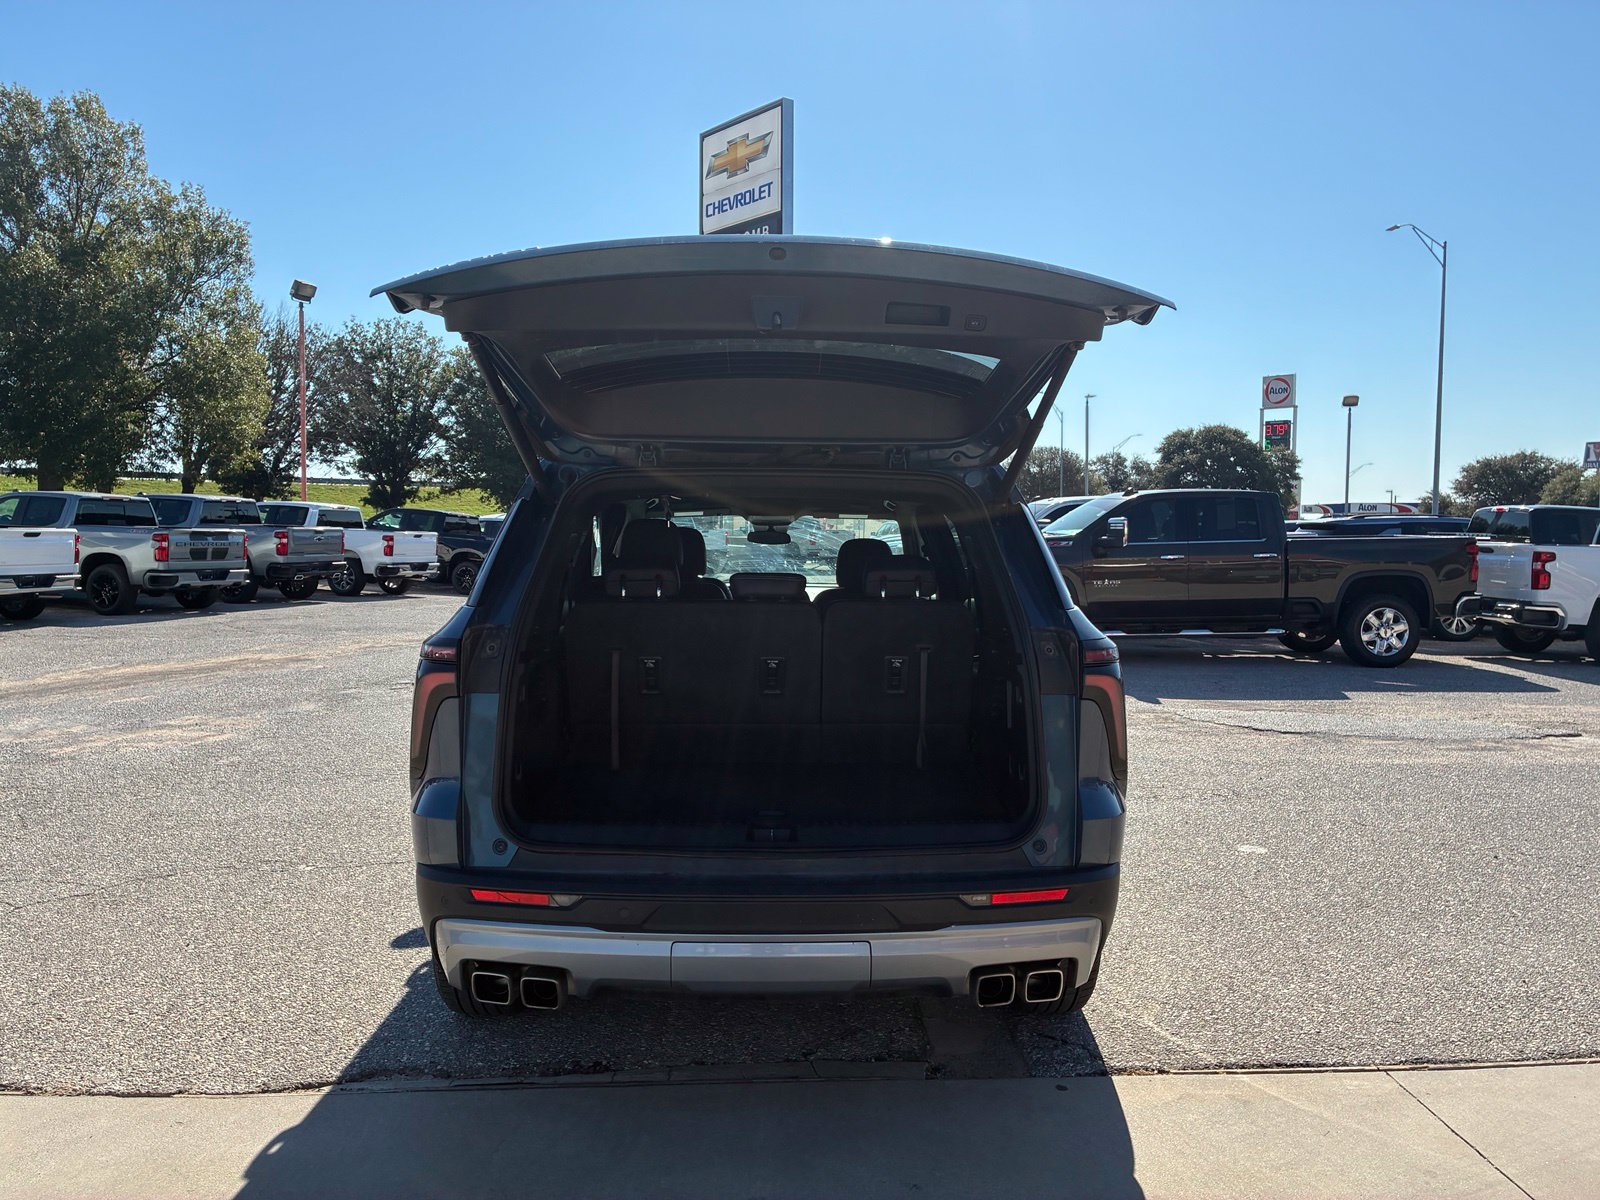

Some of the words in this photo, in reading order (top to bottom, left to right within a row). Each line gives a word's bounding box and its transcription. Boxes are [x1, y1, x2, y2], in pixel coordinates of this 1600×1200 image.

[705, 181, 773, 218] CHEVROLET
[1269, 387, 1288, 395] ALON
[1358, 503, 1377, 511] ALON
